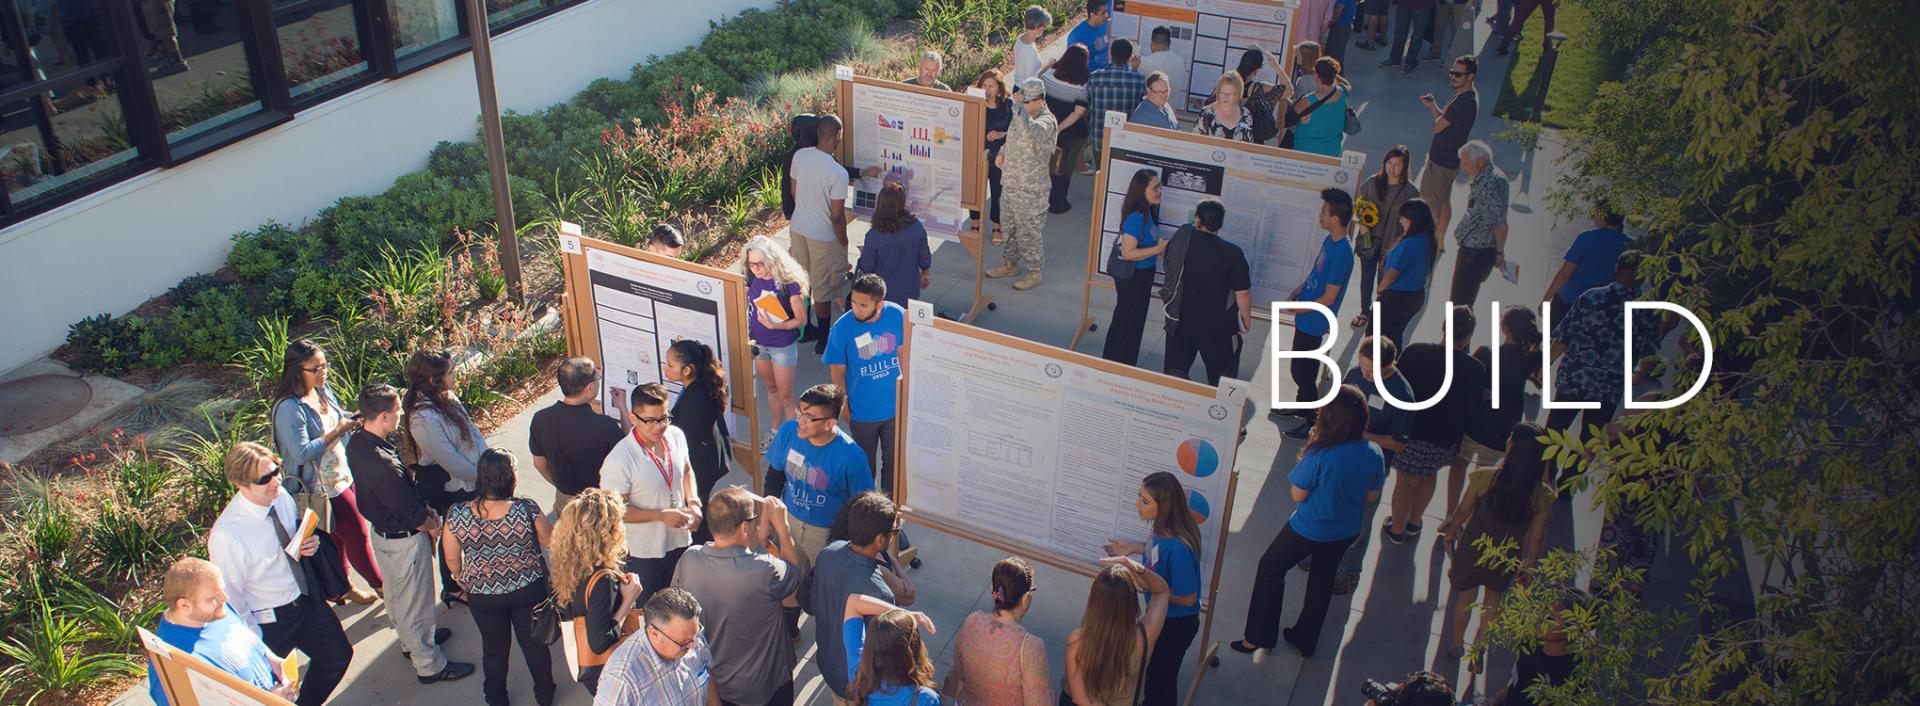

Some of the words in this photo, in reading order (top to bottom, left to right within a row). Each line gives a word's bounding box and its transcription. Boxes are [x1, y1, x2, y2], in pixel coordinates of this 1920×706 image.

[1111, 117, 1120, 125] 12
[1348, 155, 1358, 164] 13
[568, 240, 575, 250] 5
[918, 308, 925, 319] 6
[1228, 386, 1236, 398] 7
